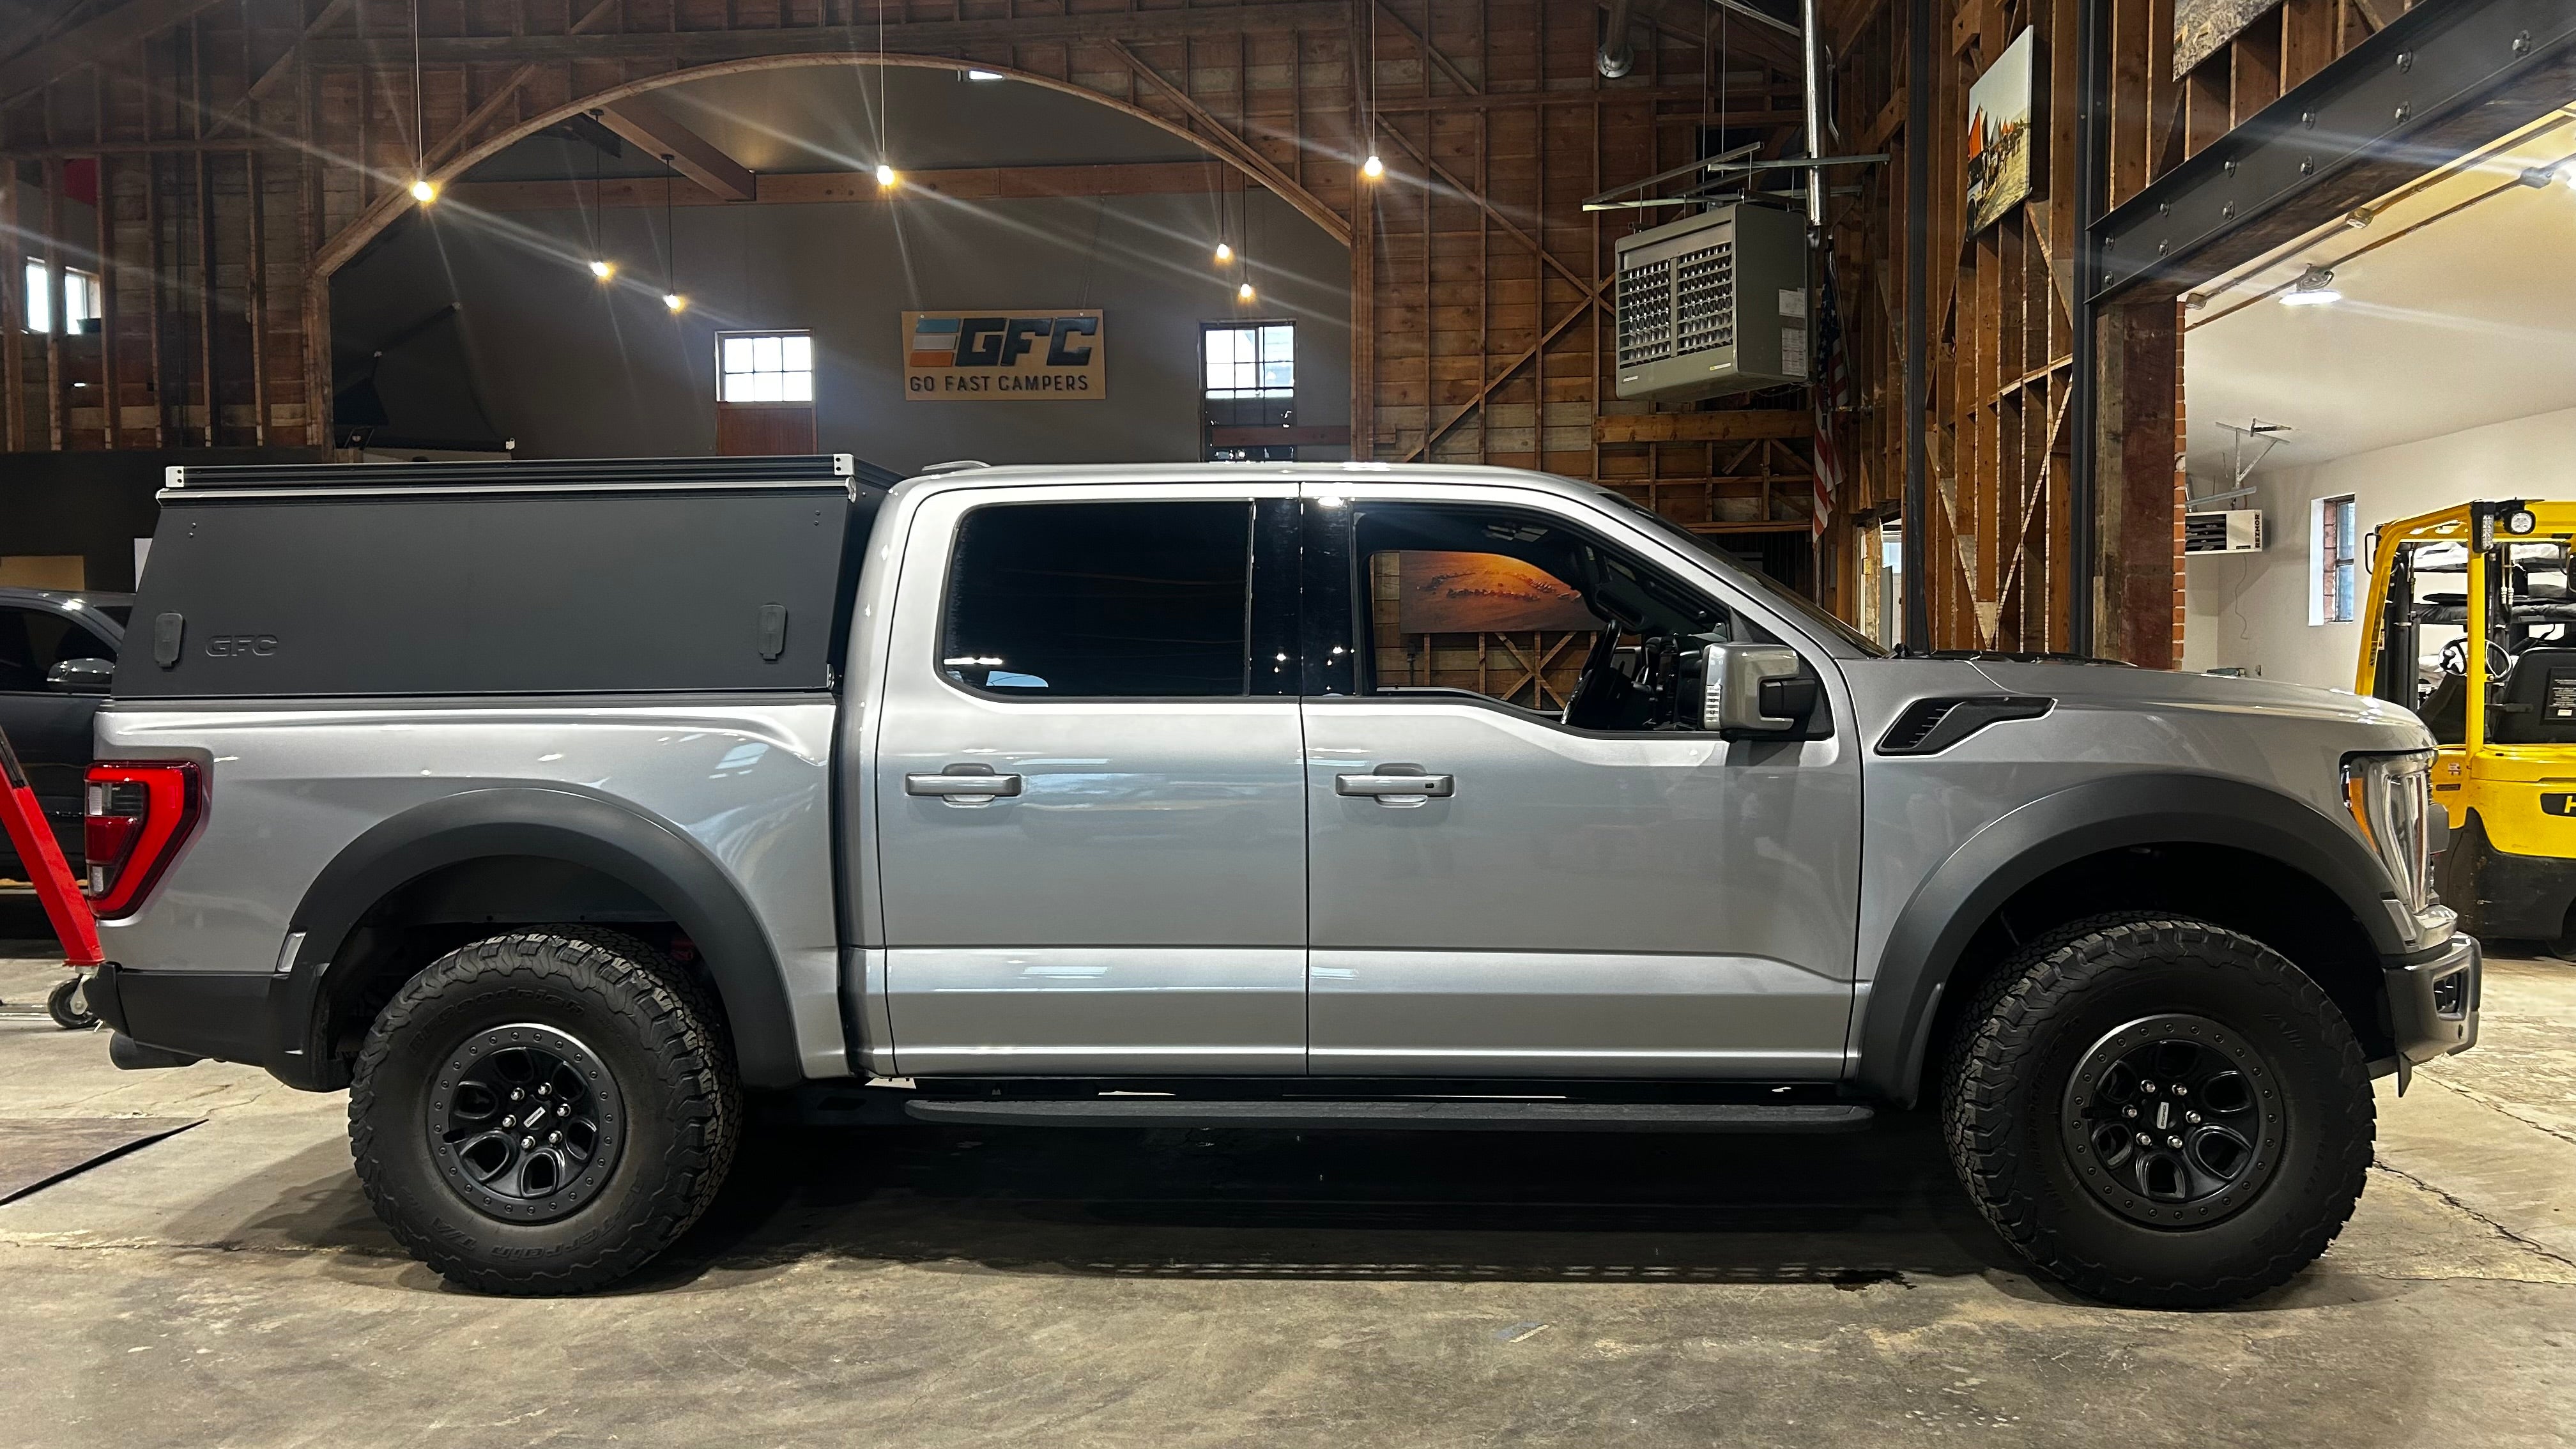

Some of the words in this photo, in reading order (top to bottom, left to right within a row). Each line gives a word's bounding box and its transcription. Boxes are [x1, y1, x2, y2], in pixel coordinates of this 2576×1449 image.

[955, 317, 1098, 367] GFC
[910, 376, 935, 392] GO
[945, 376, 992, 392] FAST
[998, 375, 1088, 392] CAMPERS
[205, 634, 279, 657] GFC
